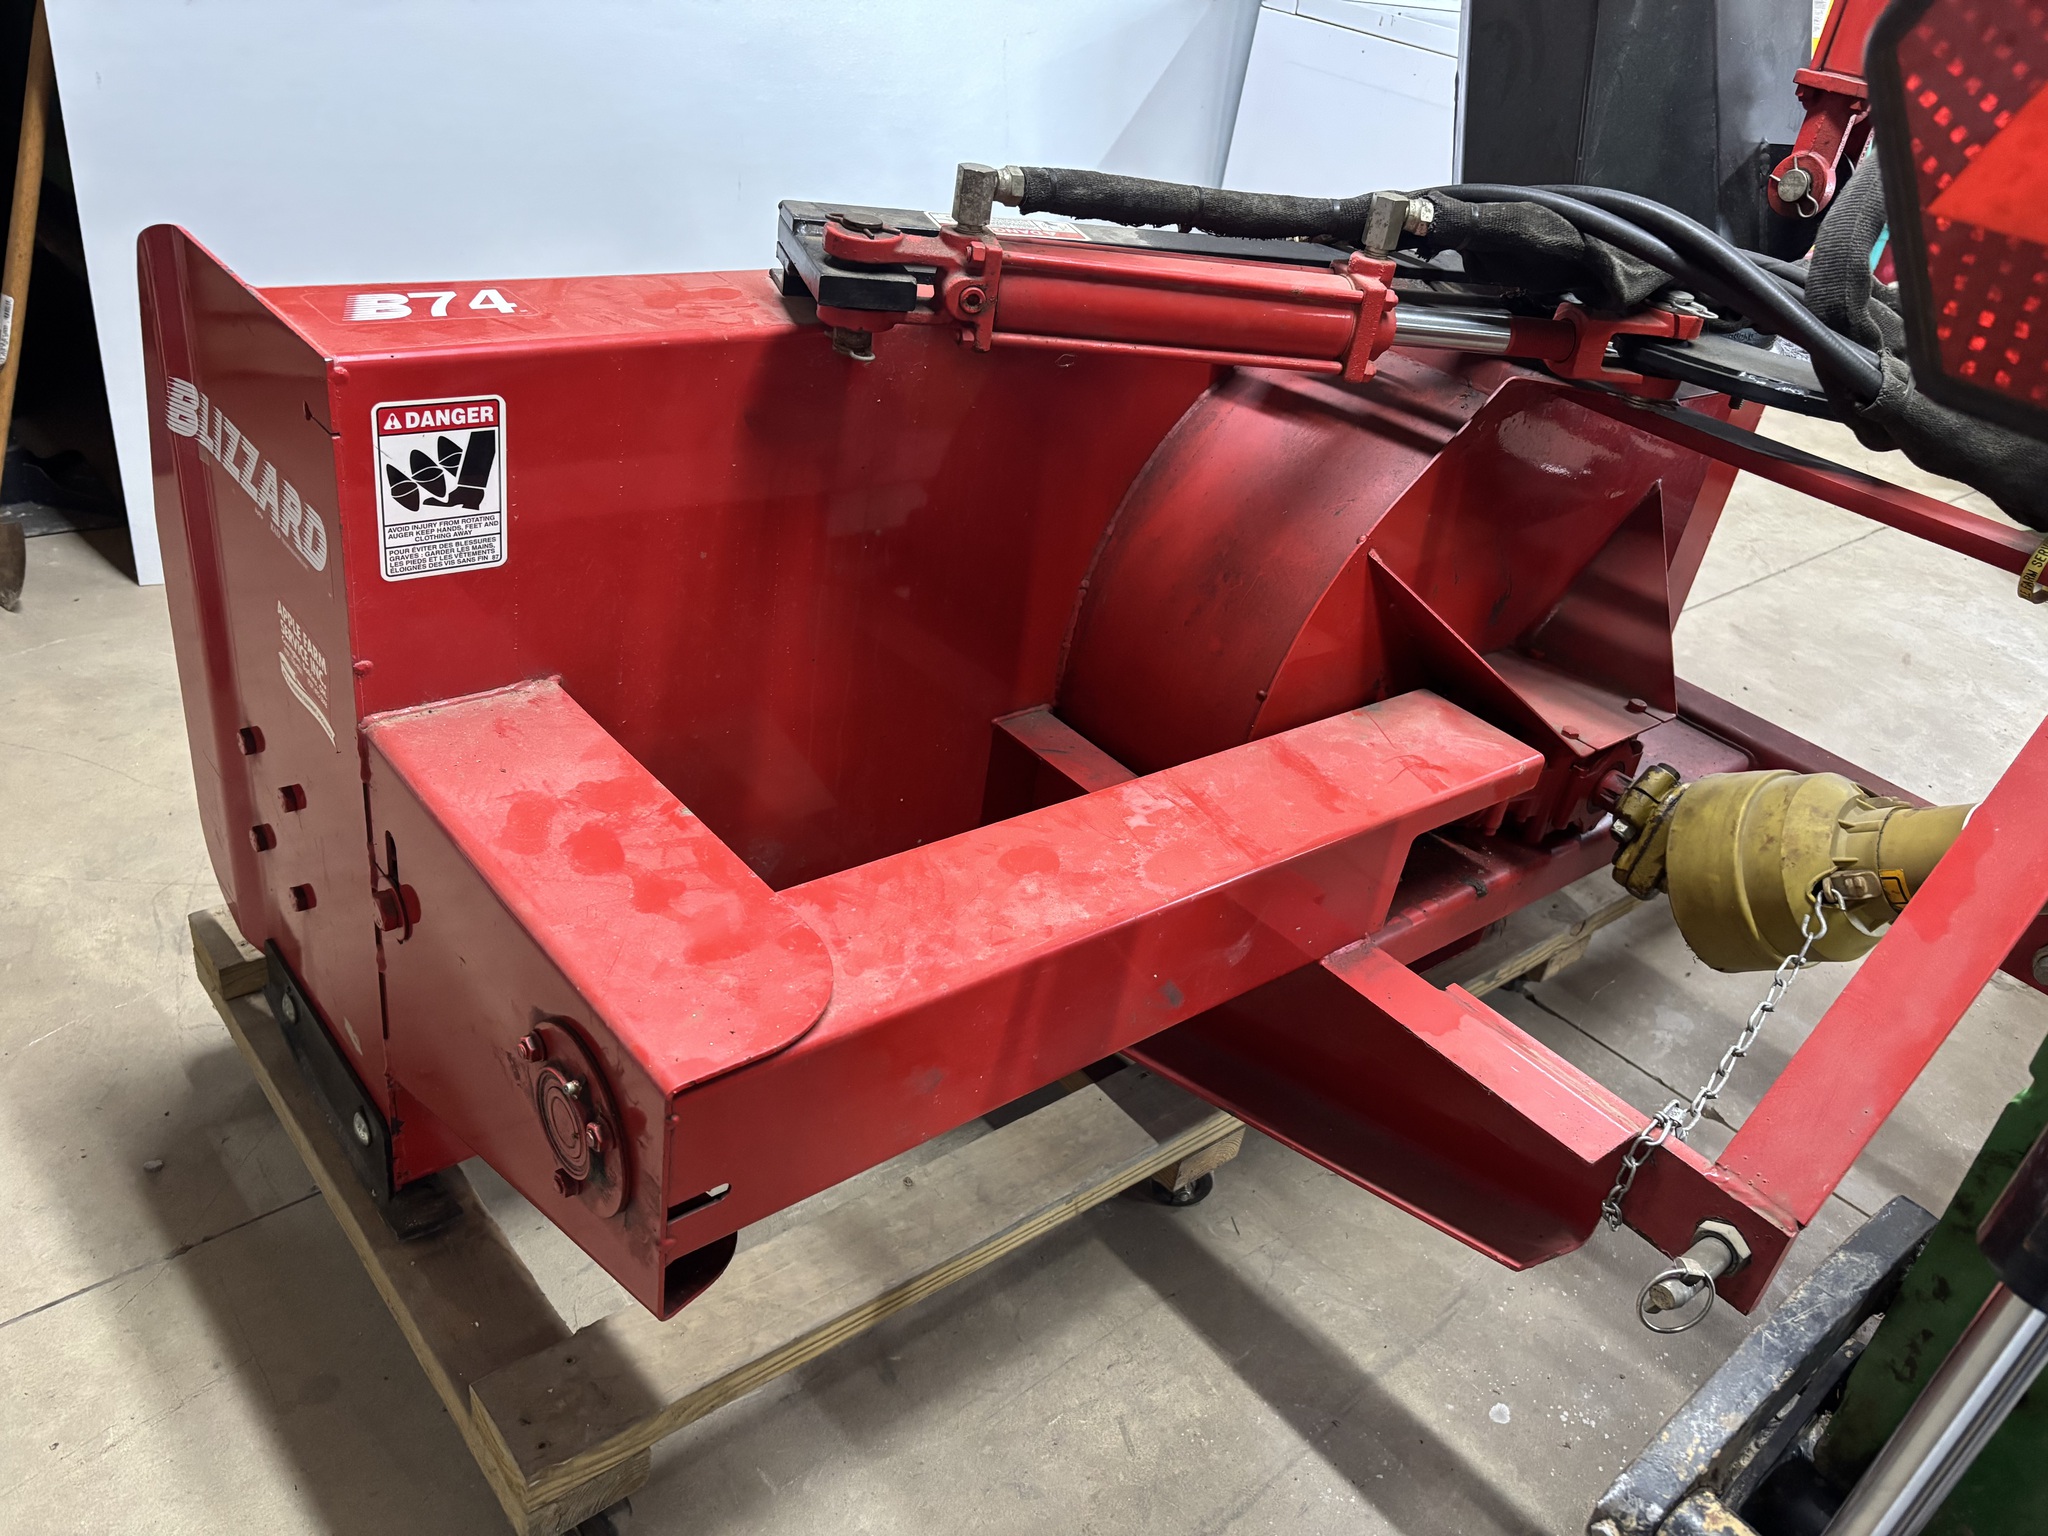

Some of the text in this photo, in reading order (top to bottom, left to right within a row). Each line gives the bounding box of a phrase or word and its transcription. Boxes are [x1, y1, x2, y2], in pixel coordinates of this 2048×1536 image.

[343, 288, 518, 321] B74
[405, 406, 494, 429] DANGER
[166, 376, 327, 571] BLIZZARD
[388, 515, 495, 534] AVOID INJURY FROM ROTATING
[388, 532, 414, 540] AUGER
[437, 525, 464, 534] HANDS,
[389, 549, 410, 557] POUR
[411, 545, 438, 553] ÉVITER
[455, 537, 497, 545] BLESSURES
[415, 533, 452, 542] CLOTHING
[389, 553, 420, 562] GRAVES
[425, 548, 455, 557] GARDER
[389, 560, 404, 568] LES
[405, 558, 427, 566] PIEDS
[454, 549, 496, 559] VÊTEMENTS
[457, 557, 476, 565] SANS
[2021, 569, 2039, 590] FARM
[277, 600, 302, 641] APPLE
[302, 631, 328, 675] FARM
[280, 619, 309, 667] SERVICE
